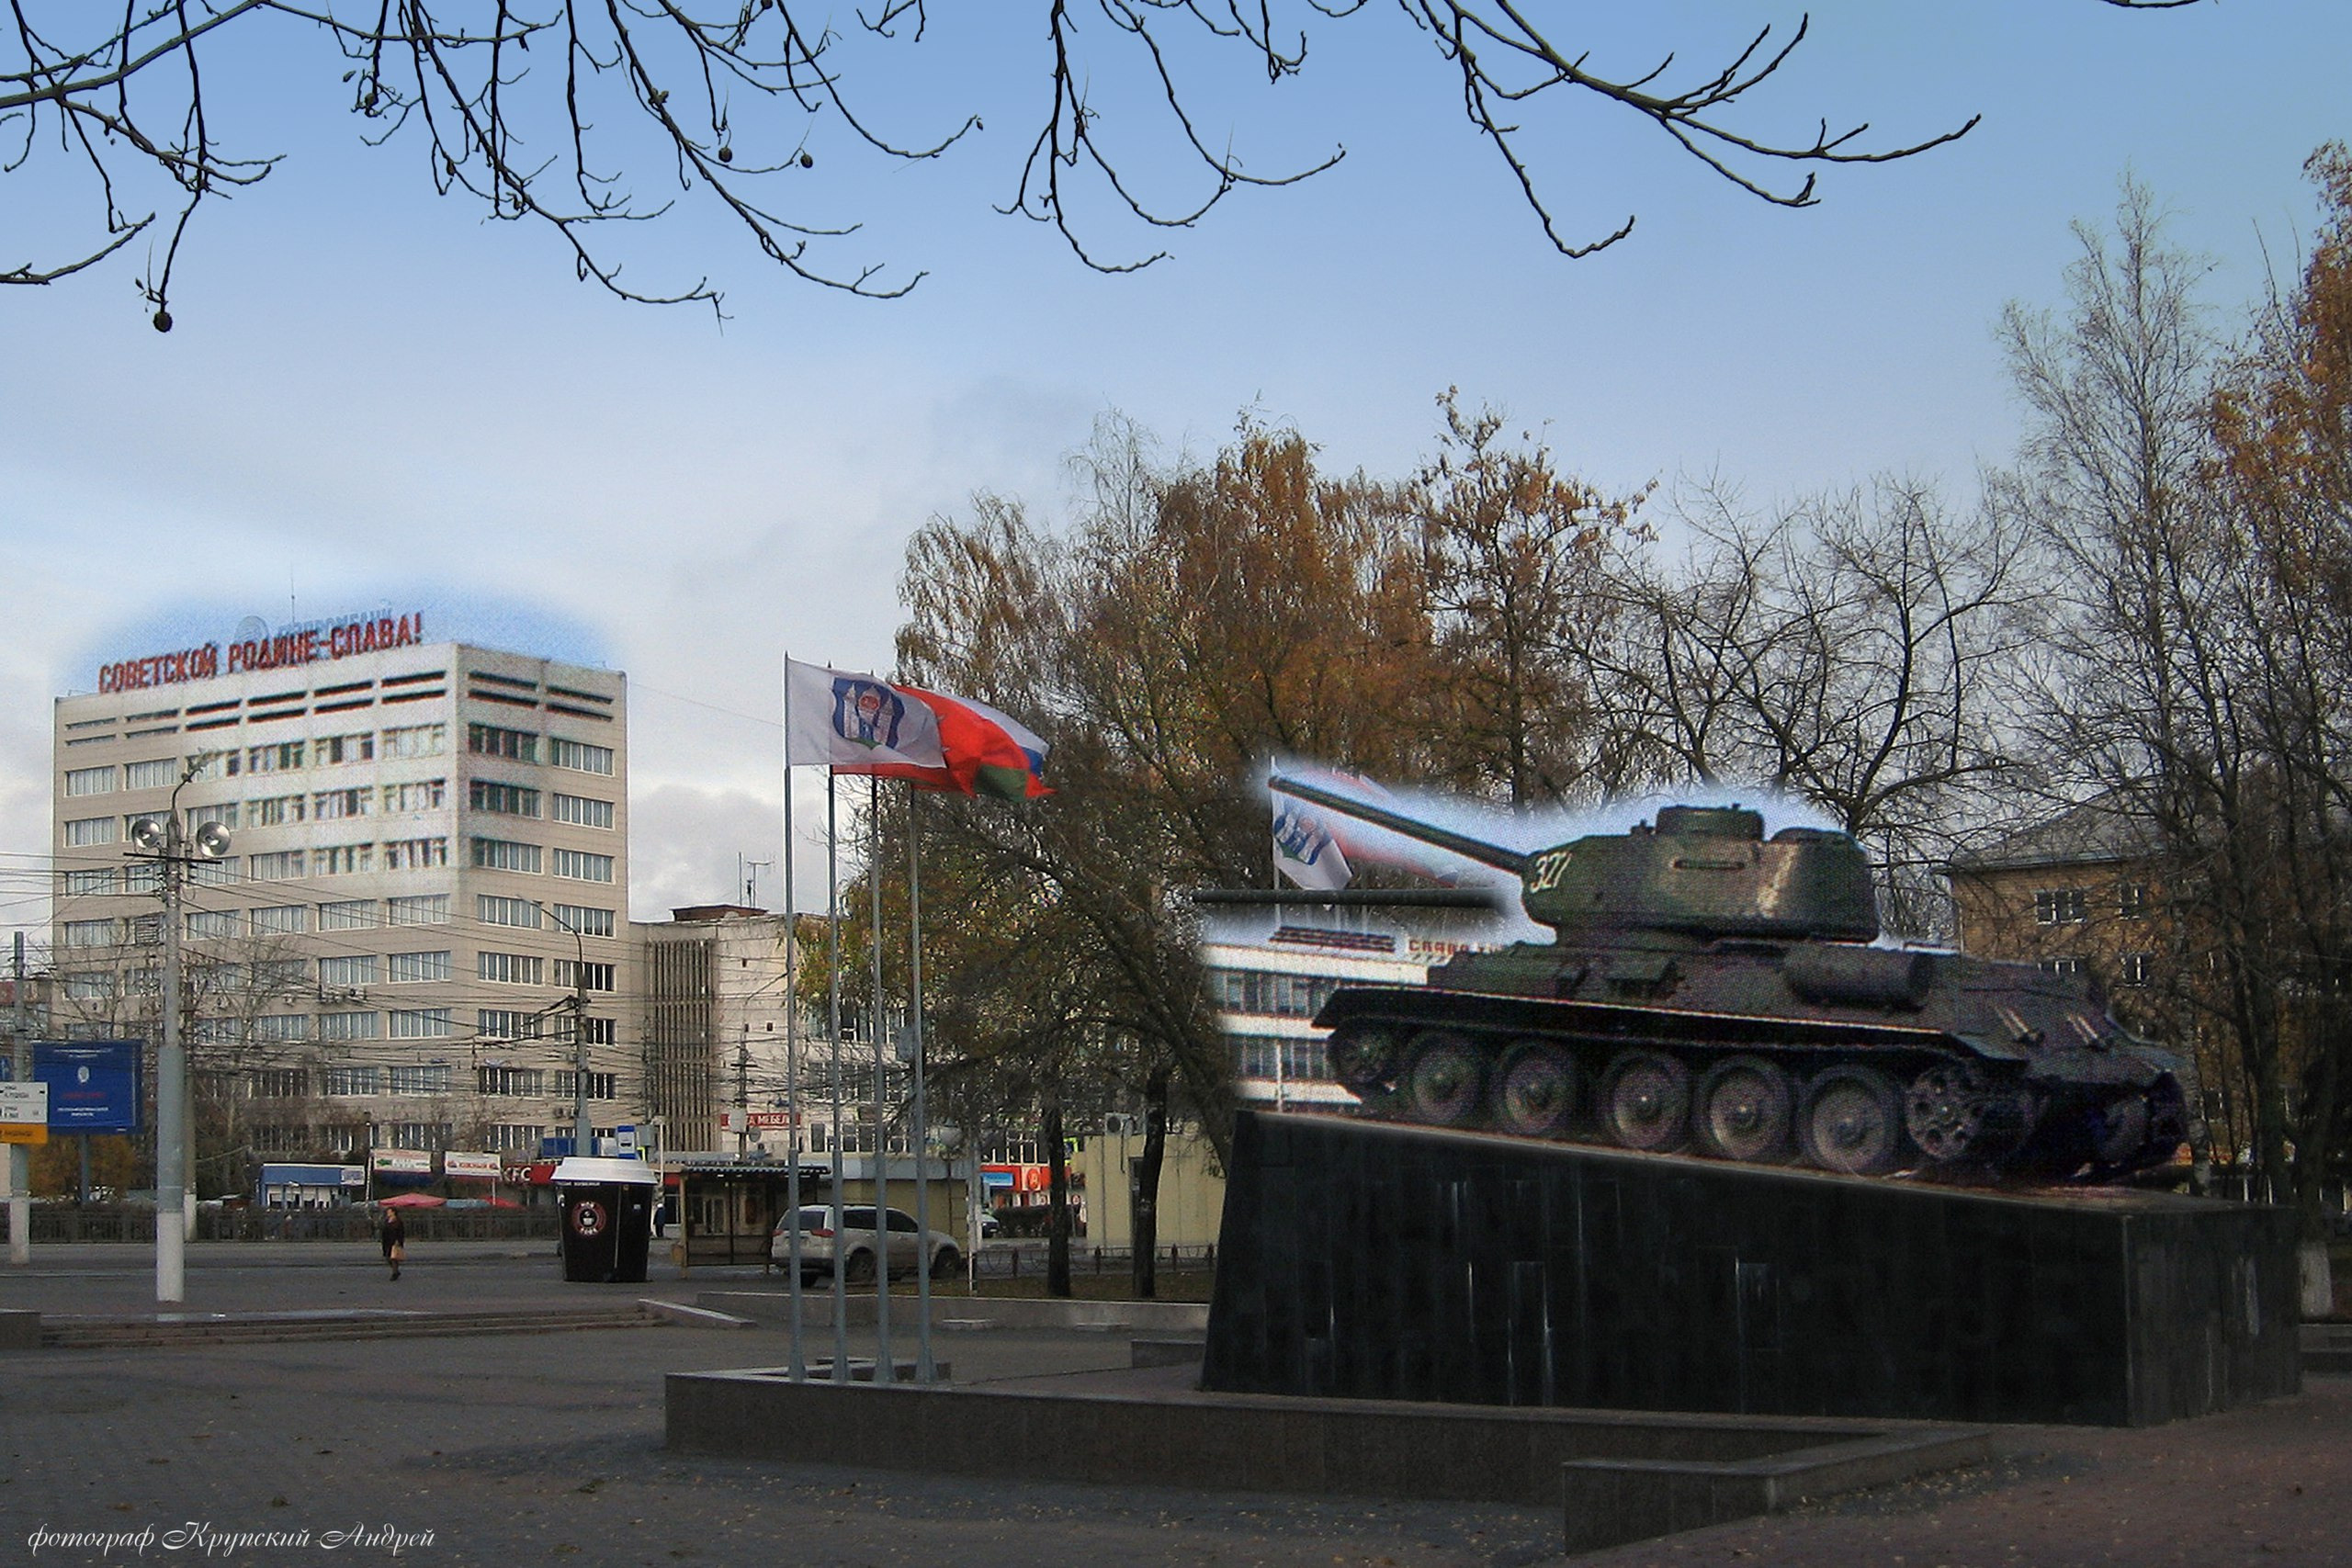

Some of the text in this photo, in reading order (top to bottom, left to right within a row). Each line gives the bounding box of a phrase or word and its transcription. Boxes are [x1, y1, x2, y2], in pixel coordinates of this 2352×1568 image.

[98, 642, 217, 693] СОВЕТСКОЙ
[1530, 852, 1572, 893] 327
[501, 1166, 532, 1184] KFC
